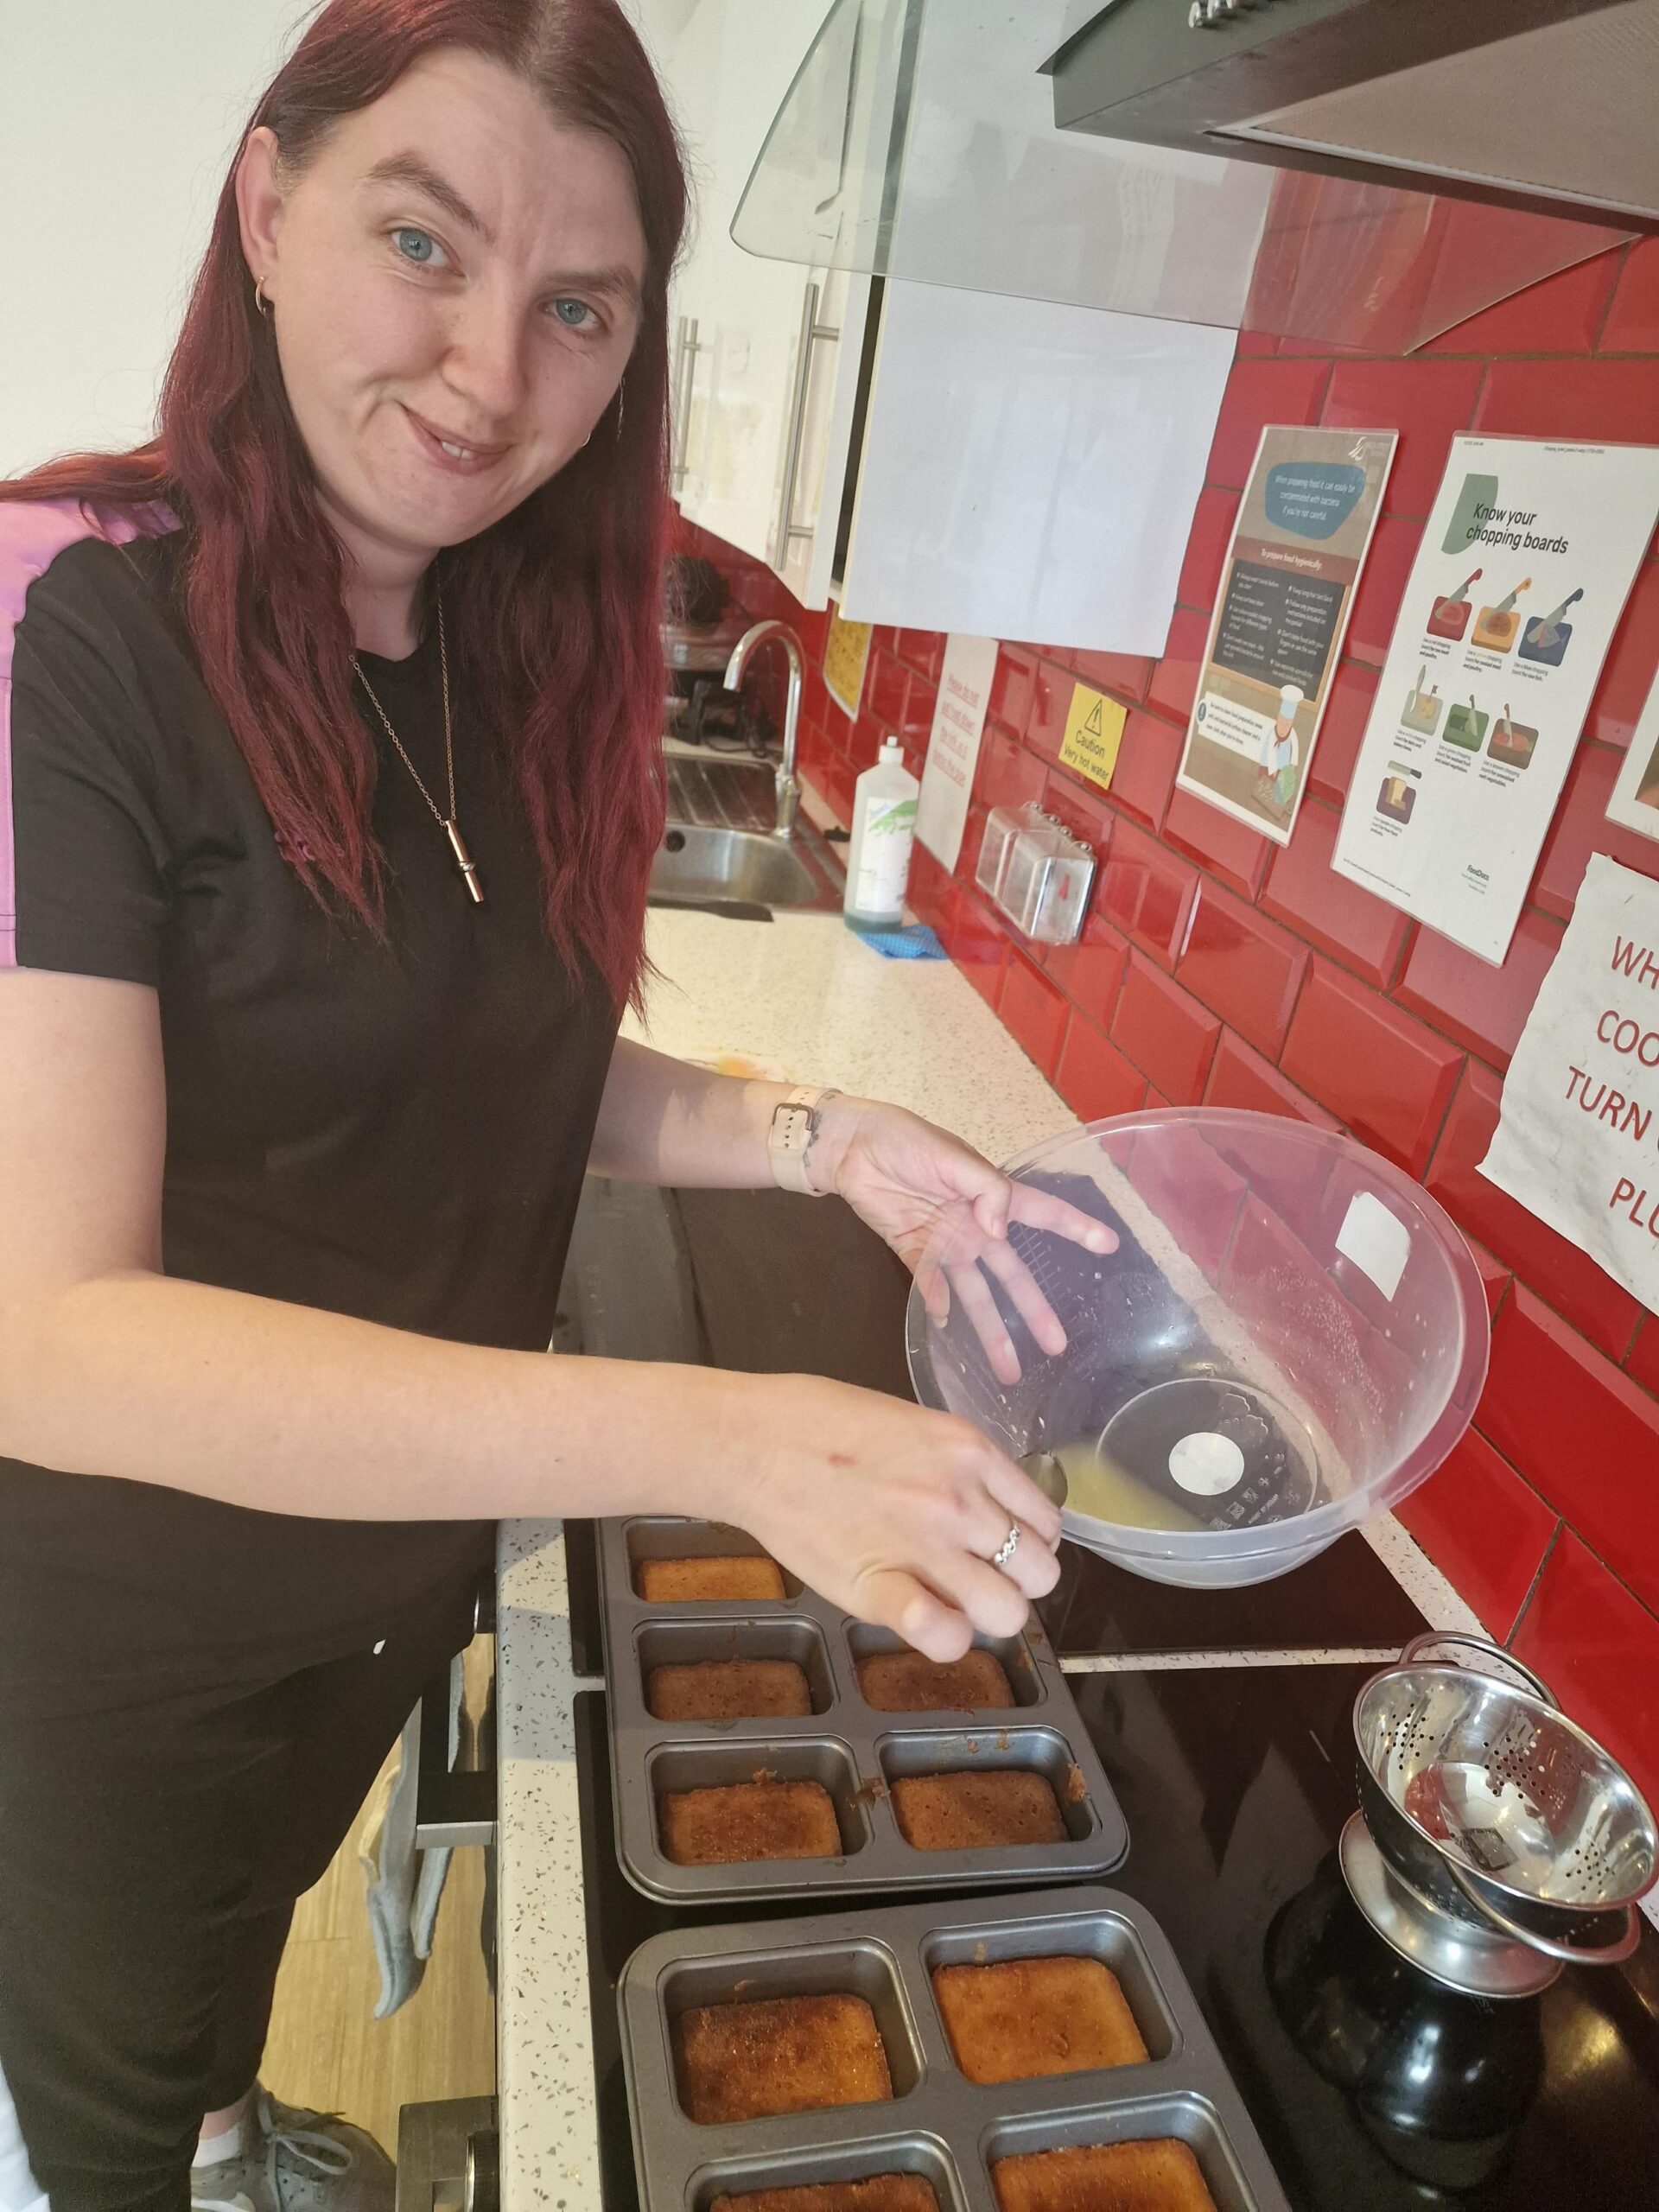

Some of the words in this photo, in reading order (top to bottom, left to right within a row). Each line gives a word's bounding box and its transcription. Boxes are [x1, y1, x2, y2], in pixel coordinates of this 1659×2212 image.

[1473, 503, 1508, 522] Know
[1506, 508, 1537, 527] your
[1466, 524, 1522, 551] chopping
[1522, 531, 1569, 554] boards
[1076, 729, 1106, 759] Caution
[1065, 743, 1078, 764] Very
[1078, 753, 1090, 769] hot
[1090, 762, 1109, 781] water
[1467, 864, 1491, 881] FoodDocs
[1565, 1065, 1653, 1141] TURN
